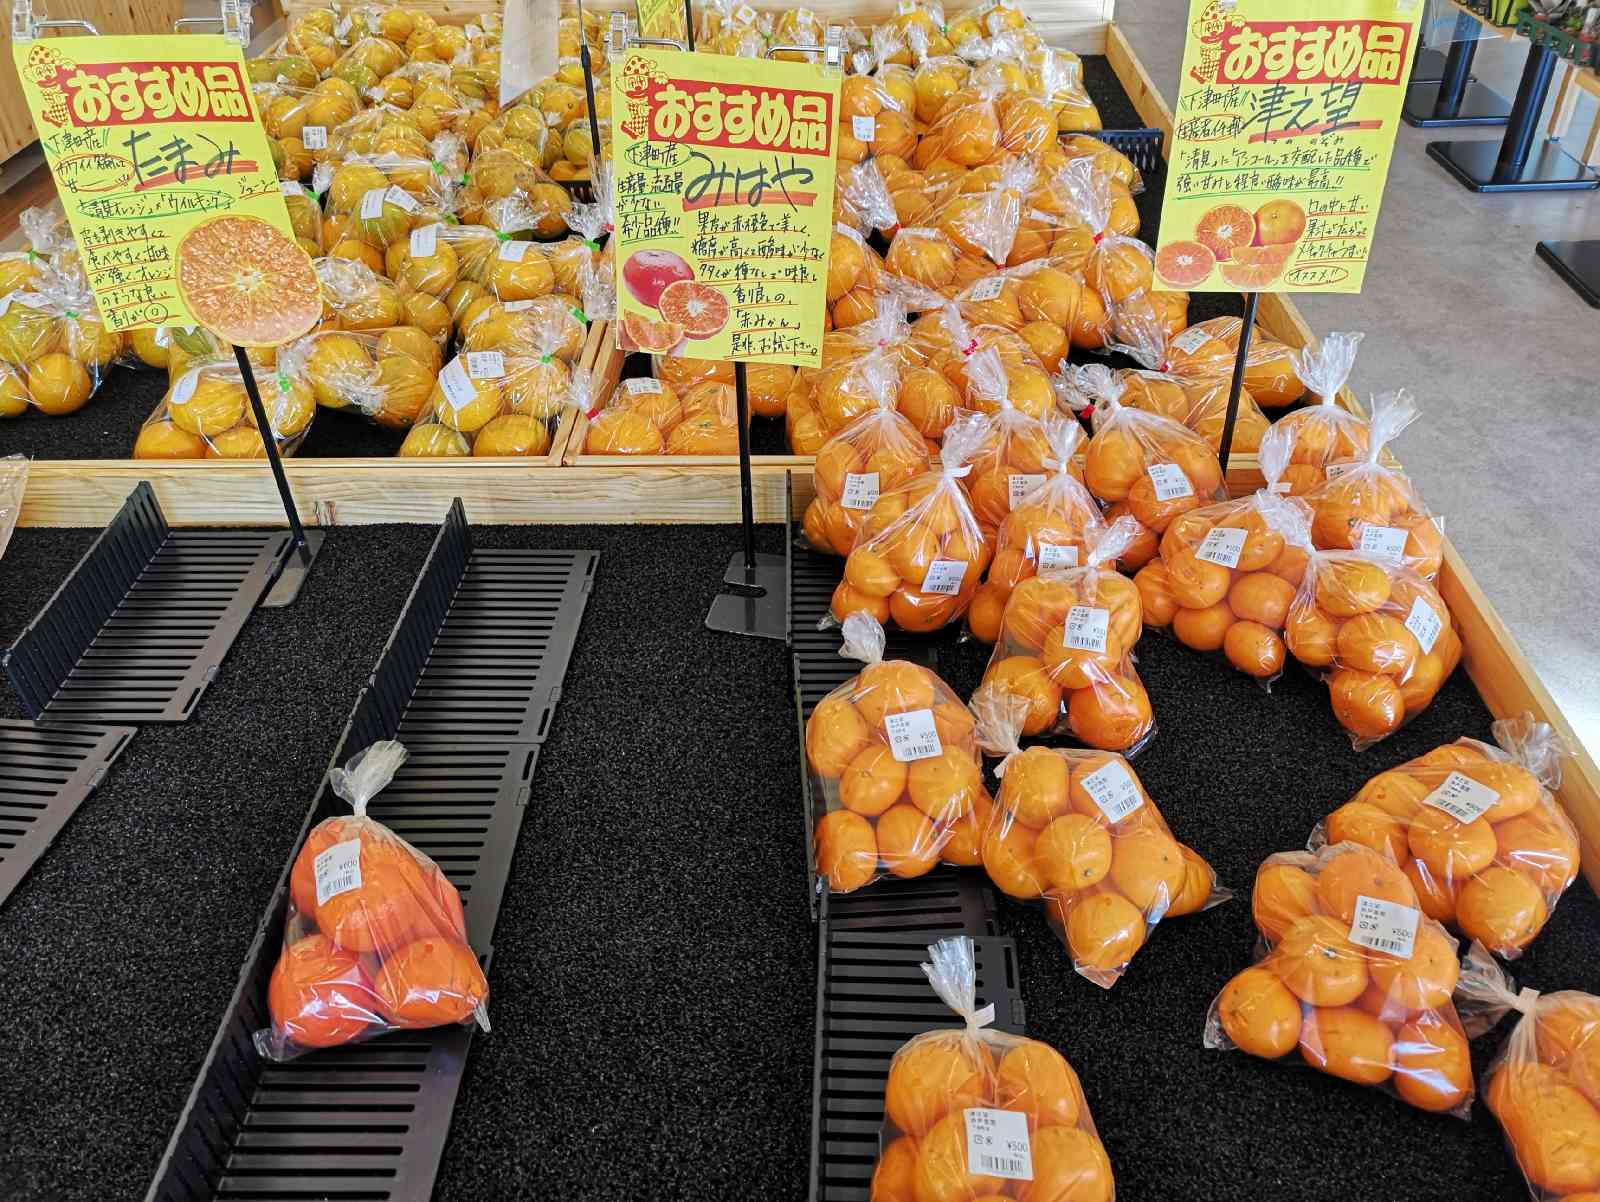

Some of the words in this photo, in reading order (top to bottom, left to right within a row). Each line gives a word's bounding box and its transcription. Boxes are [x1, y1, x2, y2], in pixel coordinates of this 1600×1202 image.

[1224, 26, 1403, 80] おすすめ品
[67, 66, 250, 121] おすすめ品
[653, 84, 828, 150] おすすめ品
[1184, 85, 1241, 112] 下津町産
[1241, 81, 1363, 143] 津之望
[121, 129, 241, 186] たまみ
[629, 141, 680, 167] 下津町産
[685, 150, 815, 213] みはや
